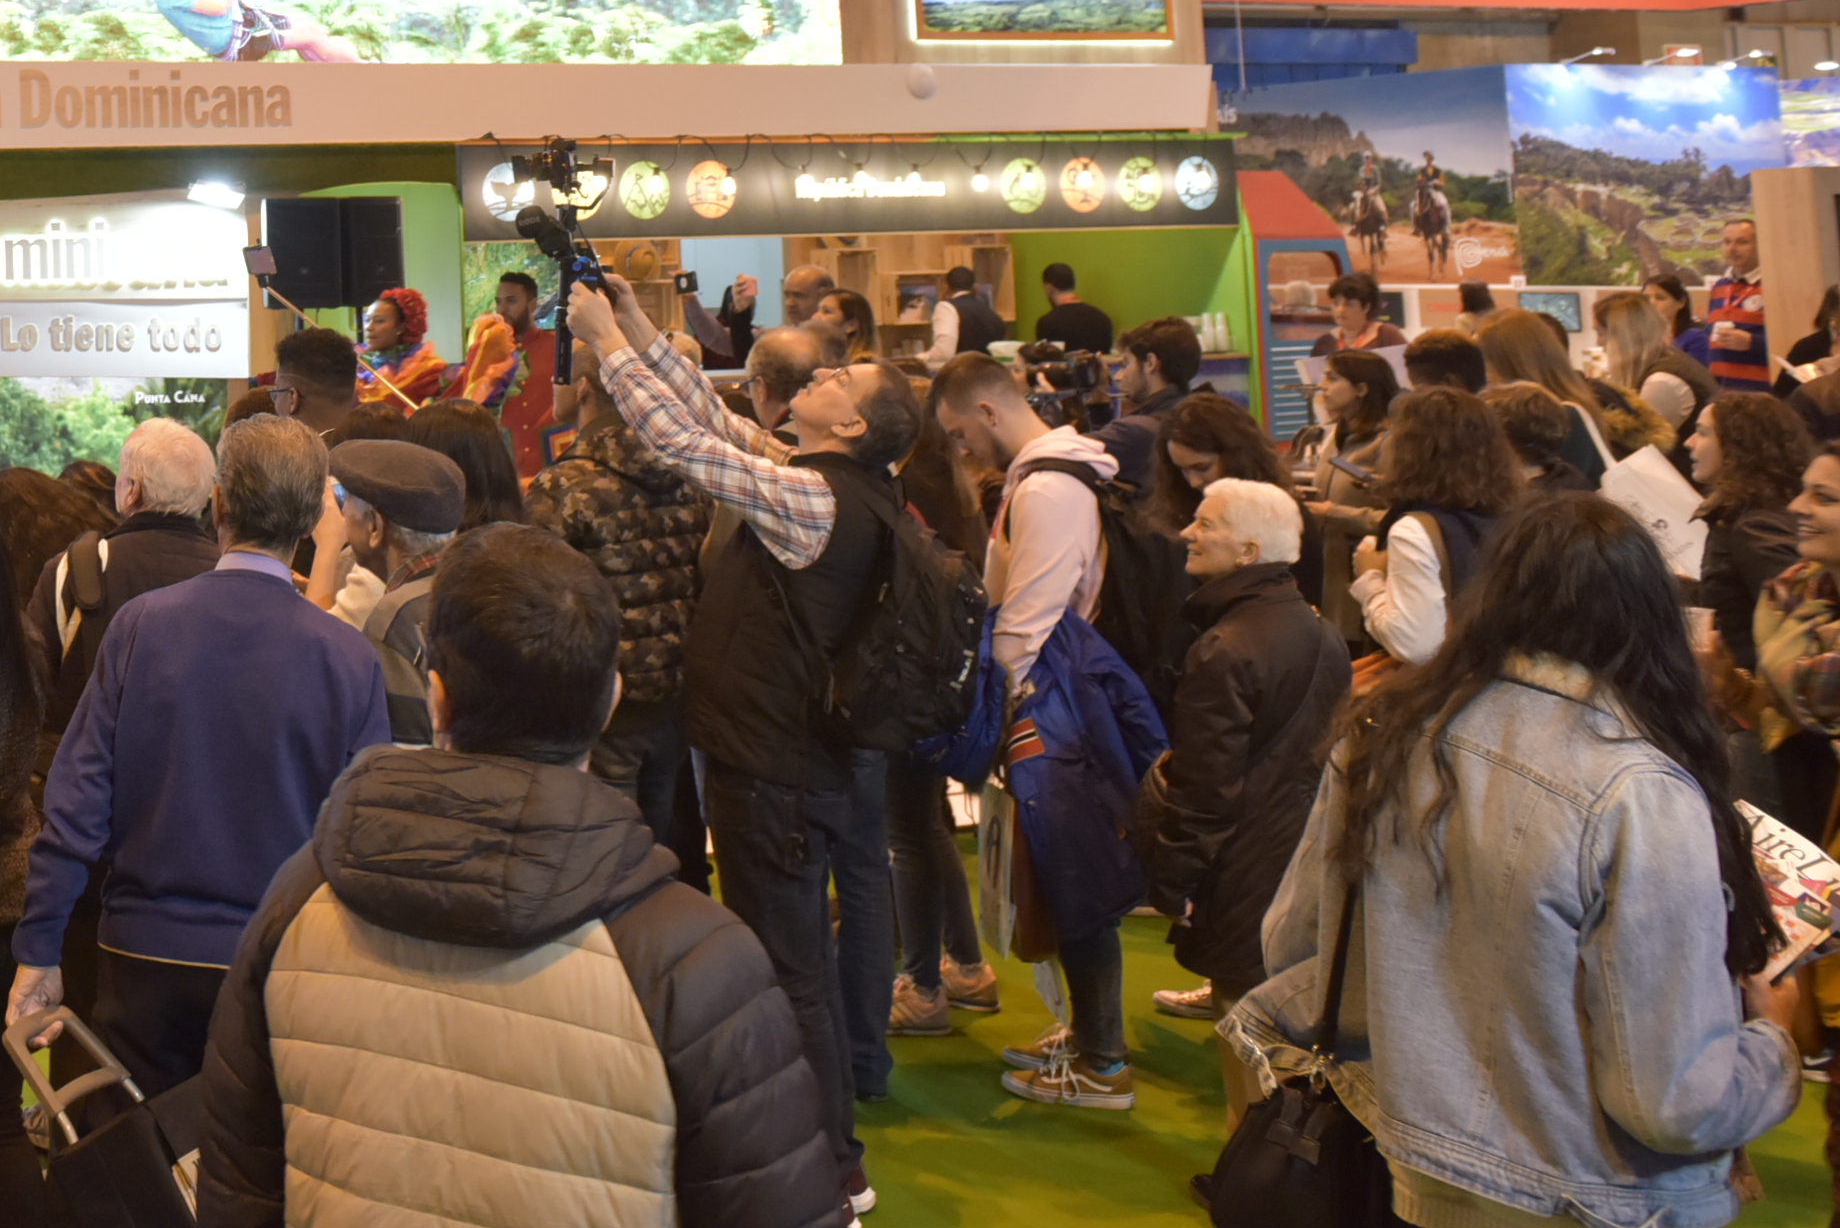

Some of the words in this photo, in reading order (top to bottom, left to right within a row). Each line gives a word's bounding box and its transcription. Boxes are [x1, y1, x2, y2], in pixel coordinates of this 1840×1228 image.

[19, 68, 293, 129] Dominicana
[0, 315, 39, 353] Lo
[48, 314, 136, 353] tiene
[147, 317, 222, 353] todo
